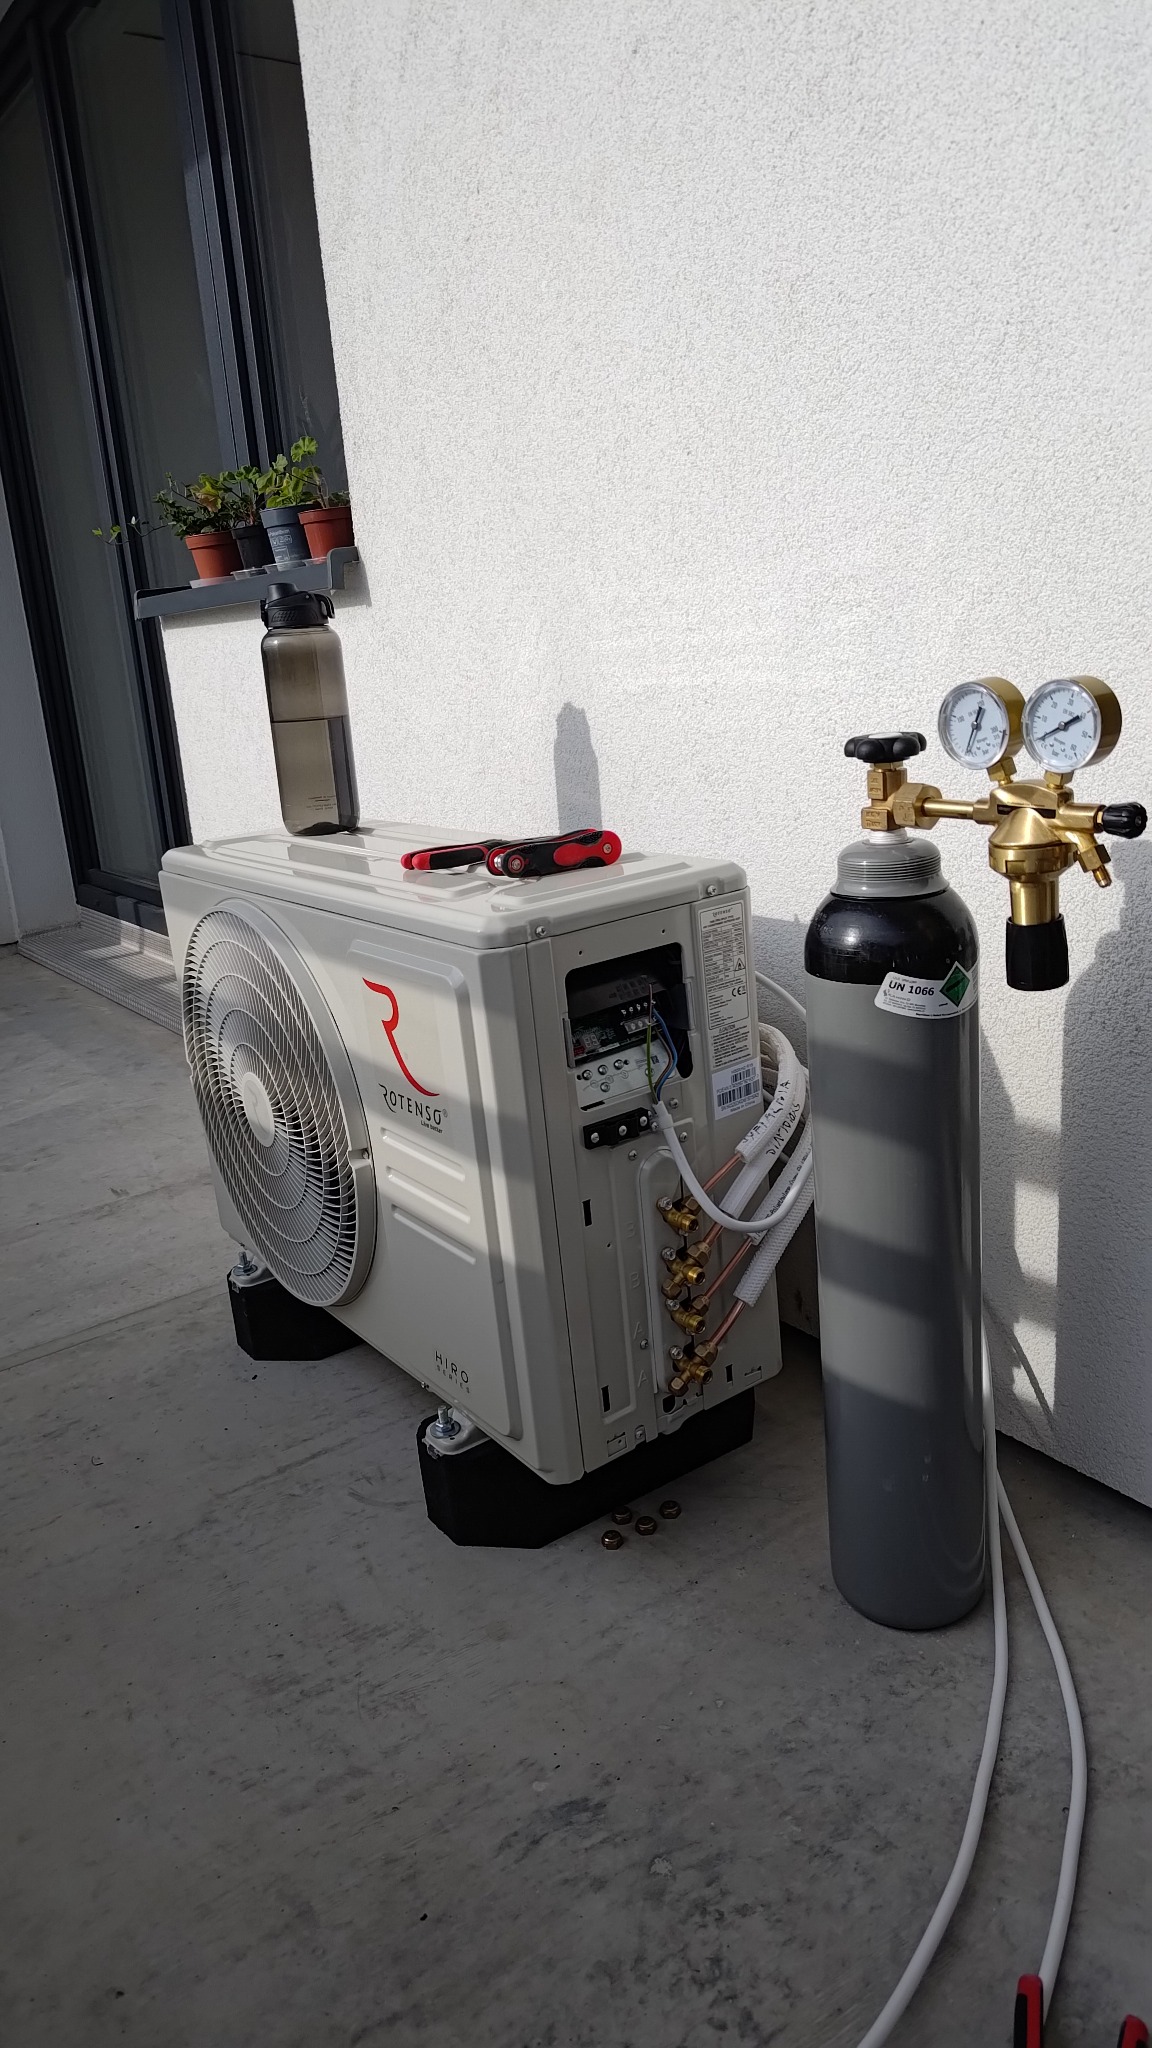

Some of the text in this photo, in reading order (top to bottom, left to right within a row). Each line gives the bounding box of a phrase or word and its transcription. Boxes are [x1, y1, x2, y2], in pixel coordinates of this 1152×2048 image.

[888, 980, 905, 992] UN
[908, 985, 935, 996] 1066
[378, 1083, 442, 1126] ROTENSO
[435, 1350, 469, 1384] HIRO
